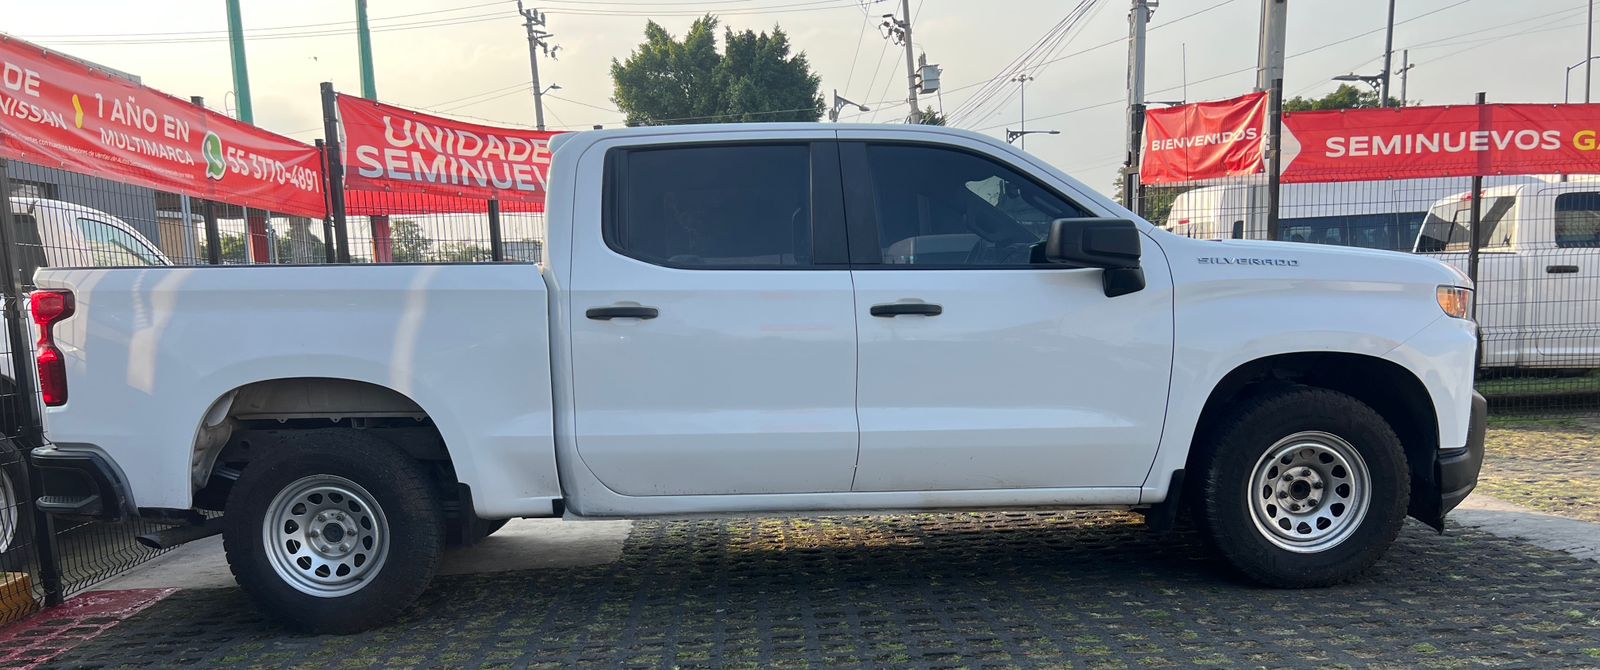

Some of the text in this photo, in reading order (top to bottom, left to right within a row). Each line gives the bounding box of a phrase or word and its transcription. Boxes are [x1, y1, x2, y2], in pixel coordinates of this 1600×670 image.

[3, 61, 40, 98] DE
[0, 94, 68, 130] NISSAN
[95, 92, 190, 143] 1 AÑO EN
[99, 127, 195, 166] MULTIMARCA
[1151, 127, 1257, 152] BIENVENIDOS
[1325, 129, 1600, 158] SEMINUEVOS G
[227, 146, 249, 176] 55
[248, 153, 319, 193] 3770-4891
[1197, 257, 1300, 267] SILVERADO
